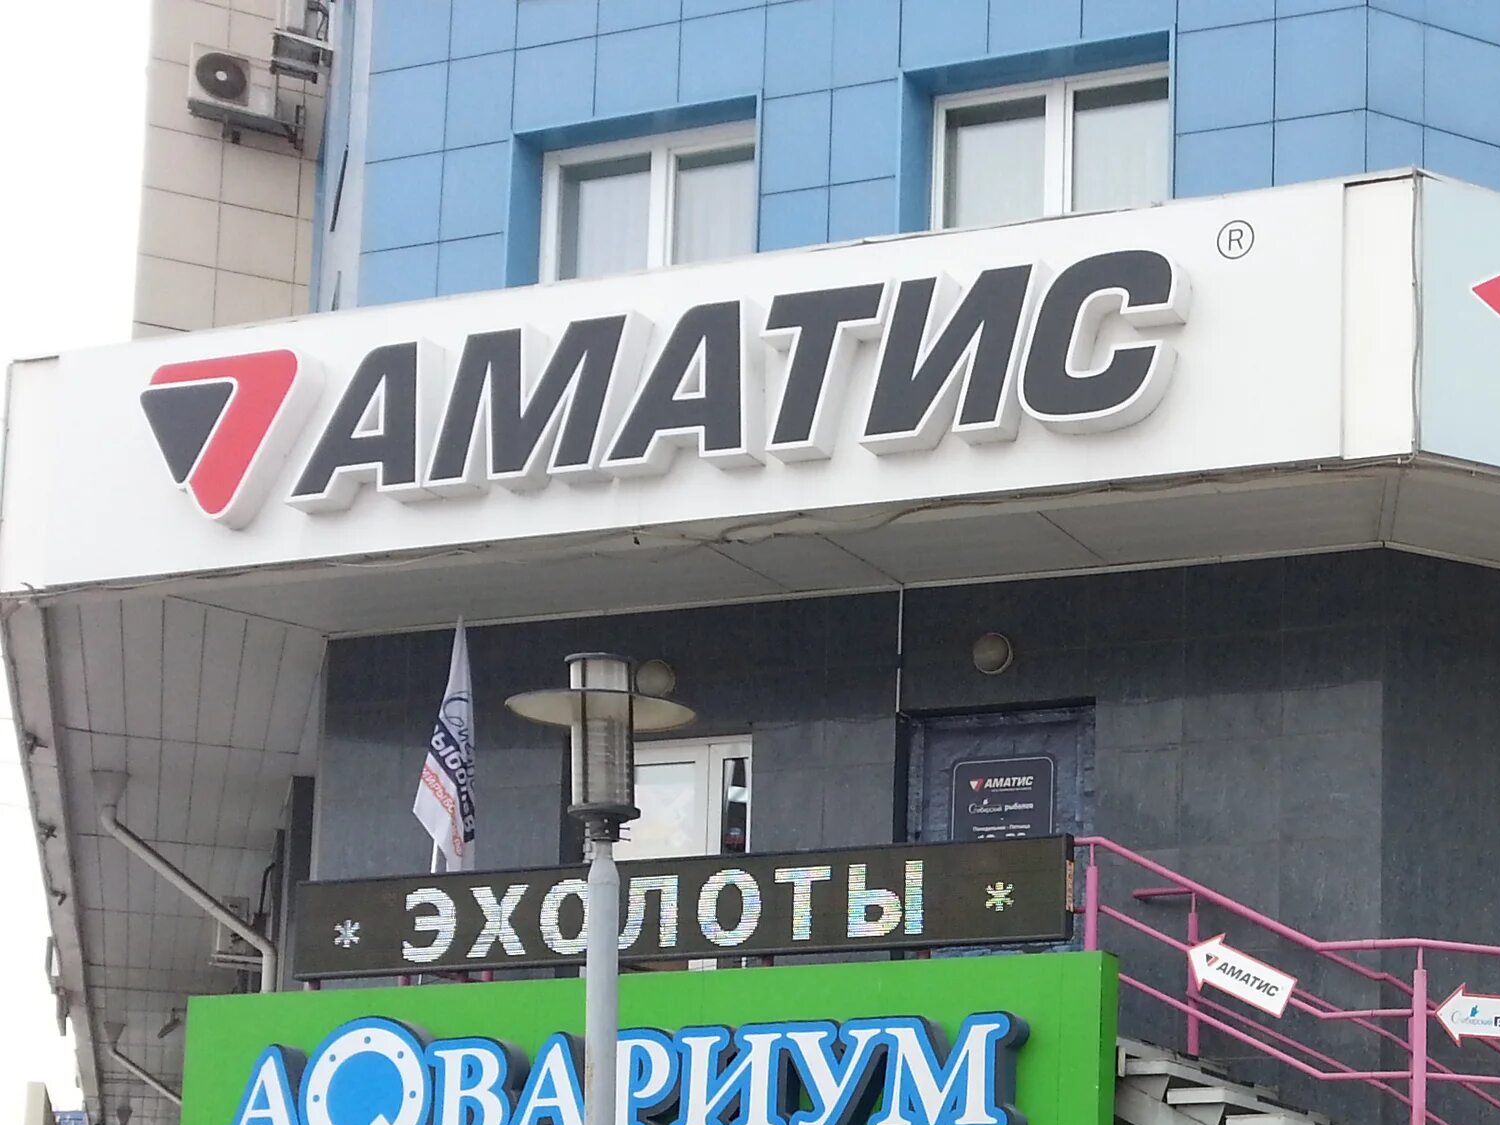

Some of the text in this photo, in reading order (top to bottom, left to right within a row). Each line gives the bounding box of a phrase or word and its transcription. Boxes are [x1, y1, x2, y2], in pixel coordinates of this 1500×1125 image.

[287, 248, 1178, 498] АМАТИС
[984, 775, 1034, 789] АМАТИС
[401, 859, 925, 963] ЭХОЛОТЫ
[1215, 961, 1279, 997] АМАТИС
